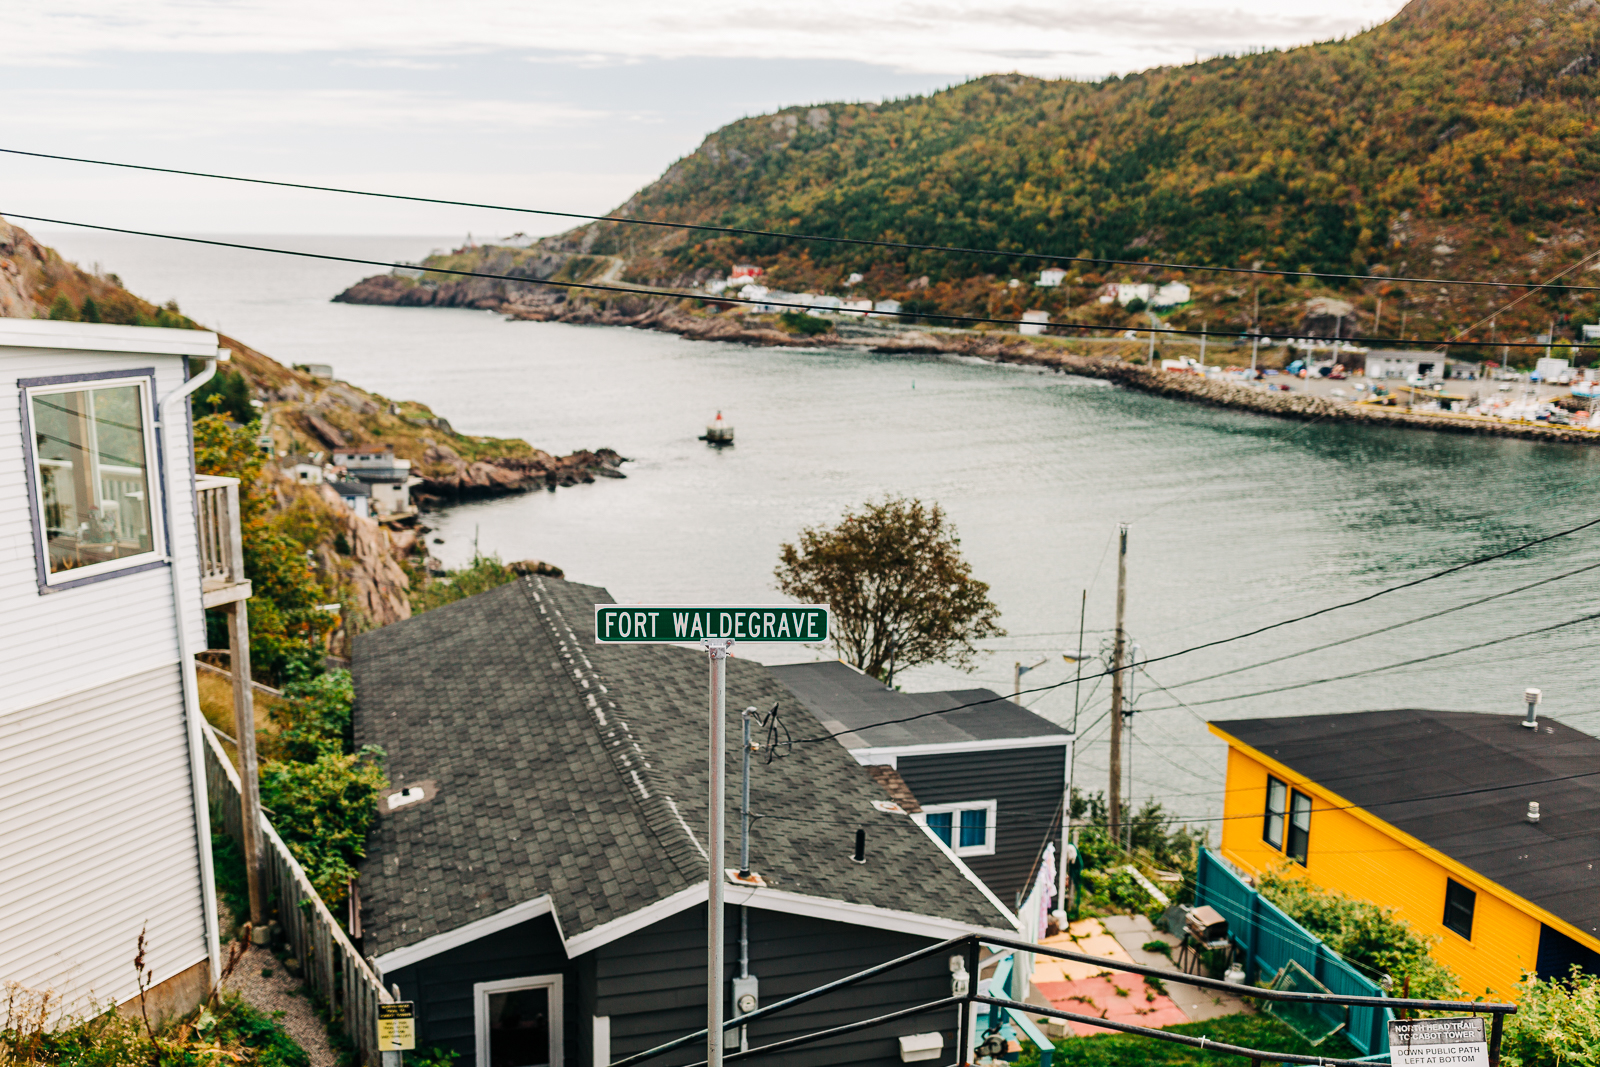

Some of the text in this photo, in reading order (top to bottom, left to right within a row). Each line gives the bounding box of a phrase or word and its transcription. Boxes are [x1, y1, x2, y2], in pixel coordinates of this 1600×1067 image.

[605, 612, 819, 638] FORT WALDEGRAVE
[1426, 1023, 1450, 1031] HEAD
[1450, 1022, 1476, 1030] TRAIL
[1412, 1032, 1442, 1040] CABOT
[1443, 1030, 1475, 1039] TOWER
[1398, 1046, 1480, 1056] DOWN PUBLIC PATH
[1404, 1055, 1475, 1065] LEFT AT BOTTOM
